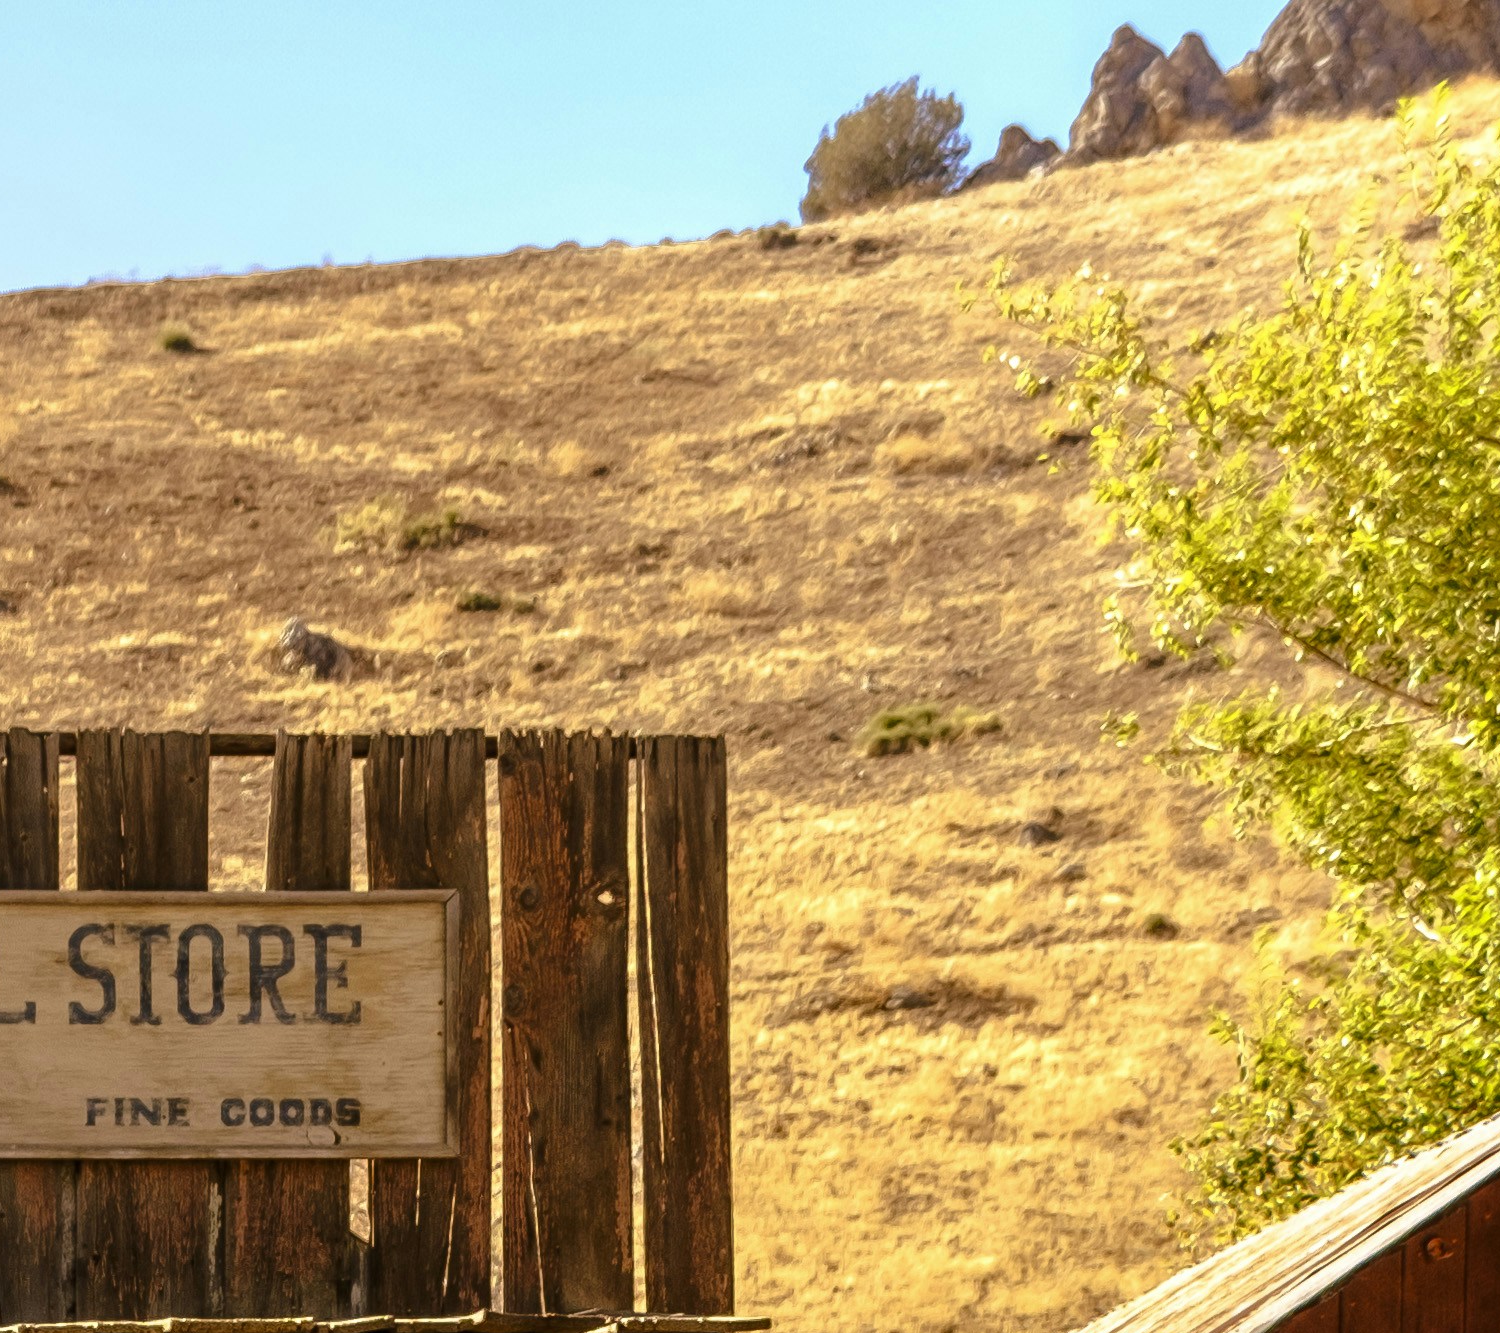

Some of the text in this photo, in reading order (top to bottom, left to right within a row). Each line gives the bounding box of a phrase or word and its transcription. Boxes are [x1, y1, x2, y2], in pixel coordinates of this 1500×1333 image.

[67, 922, 363, 1026] STORE
[84, 1097, 362, 1128] FINE GOODS
